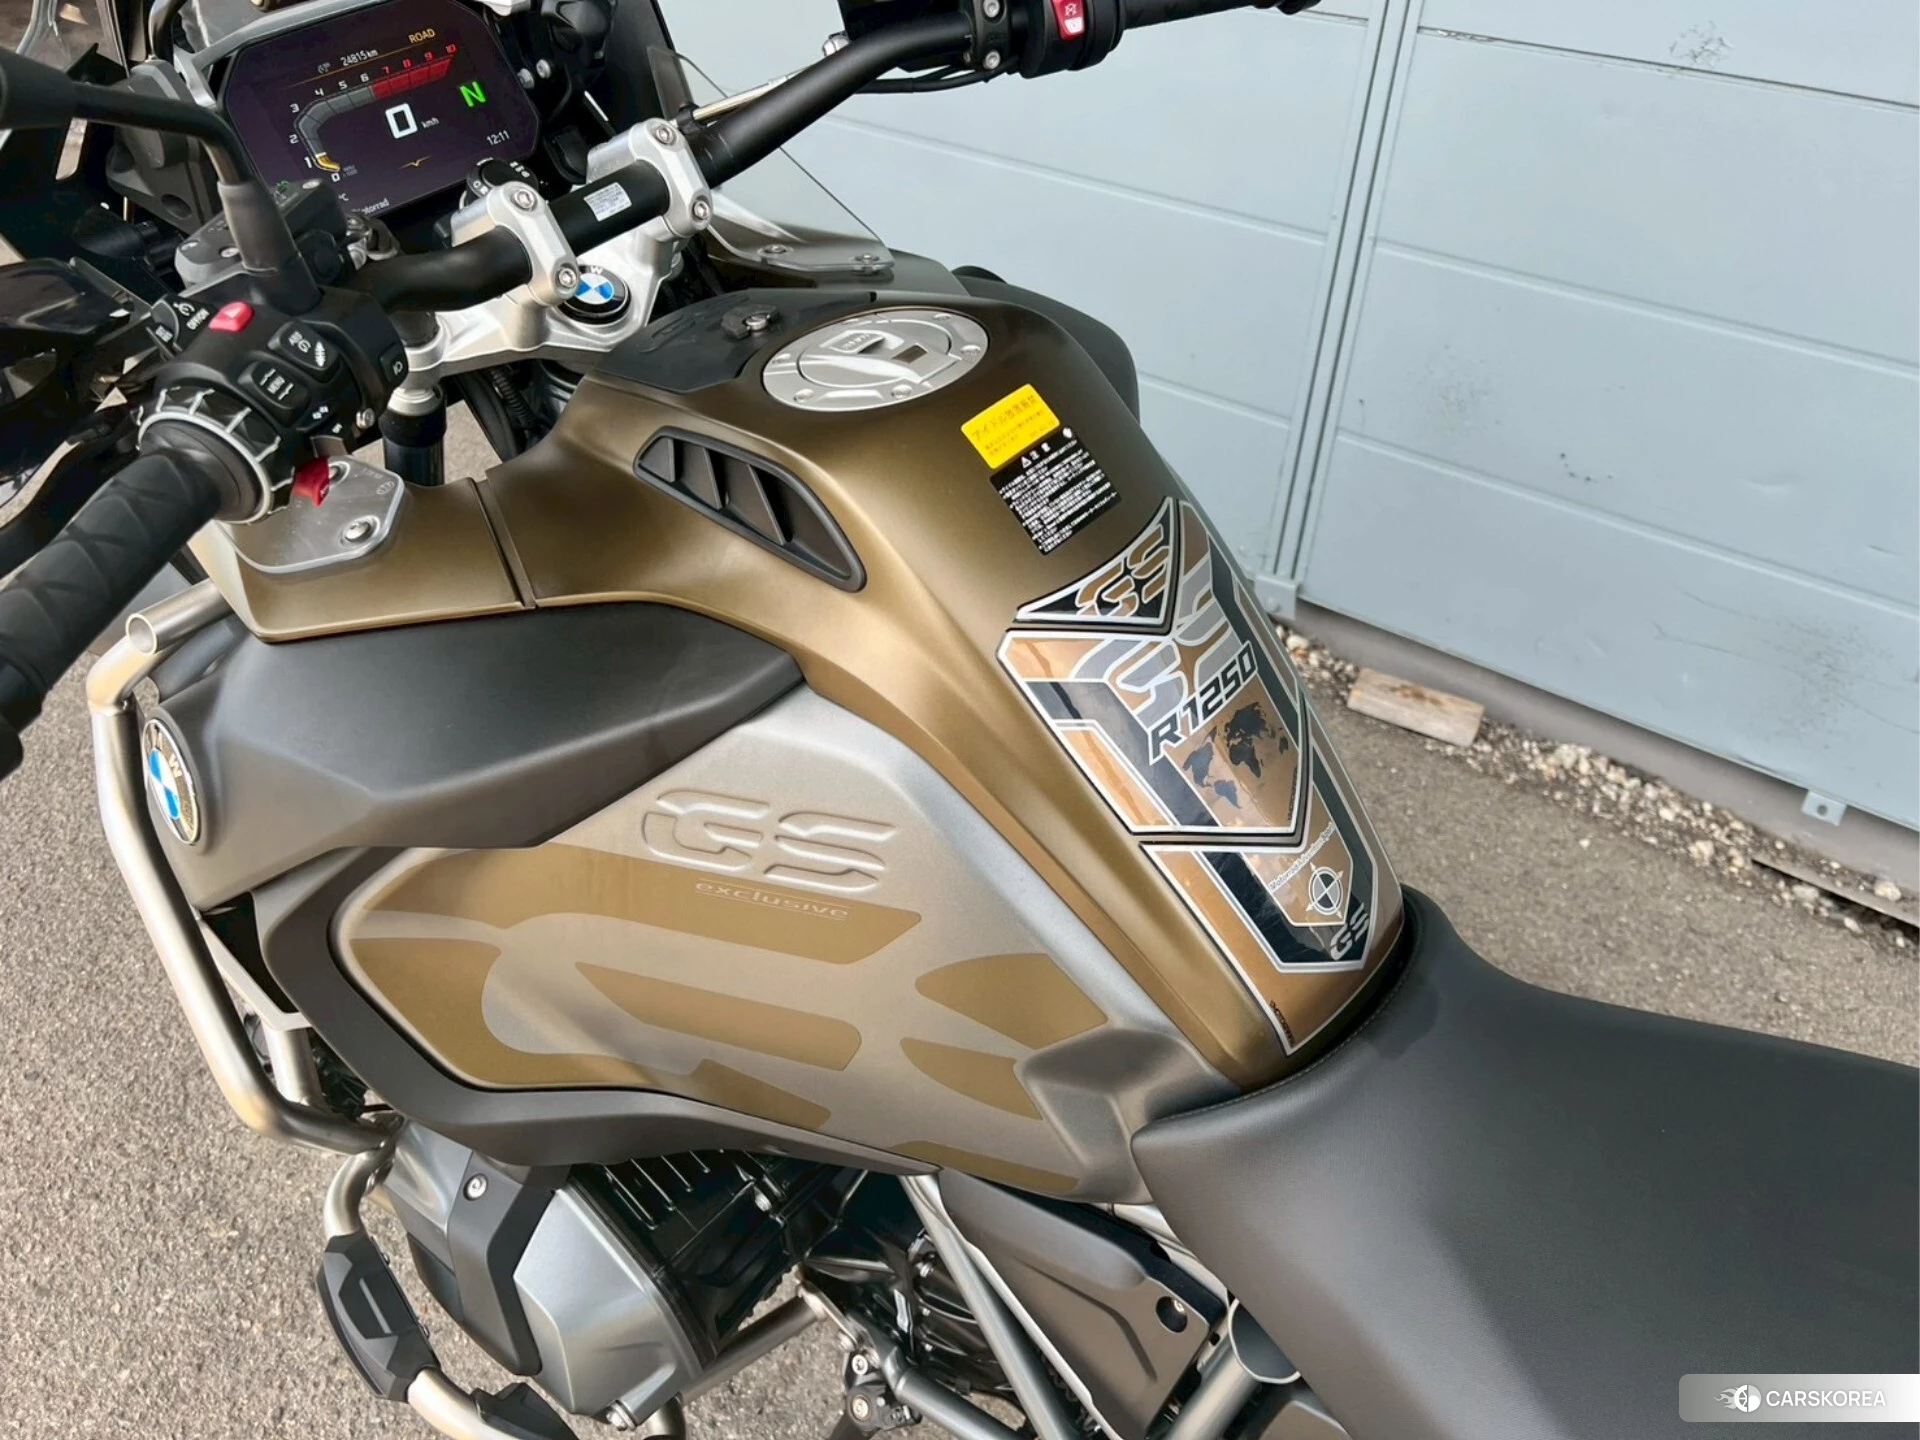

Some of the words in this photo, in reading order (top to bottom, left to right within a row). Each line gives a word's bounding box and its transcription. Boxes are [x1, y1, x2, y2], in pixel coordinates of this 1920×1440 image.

[408, 28, 436, 44] ROAD
[340, 50, 368, 67] 24815
[382, 66, 390, 74] 7
[338, 81, 348, 90] 5
[360, 73, 369, 83] 6
[315, 88, 324, 97] 4
[459, 81, 486, 107] N
[290, 103, 299, 113] 3
[385, 103, 418, 139] 0
[289, 134, 299, 144] 2
[486, 130, 510, 145] 12:11
[304, 157, 312, 168] 1
[1153, 645, 1257, 758] R1250
[642, 788, 896, 894] GS
[695, 881, 850, 919] exclusive
[1330, 903, 1370, 961] GS
